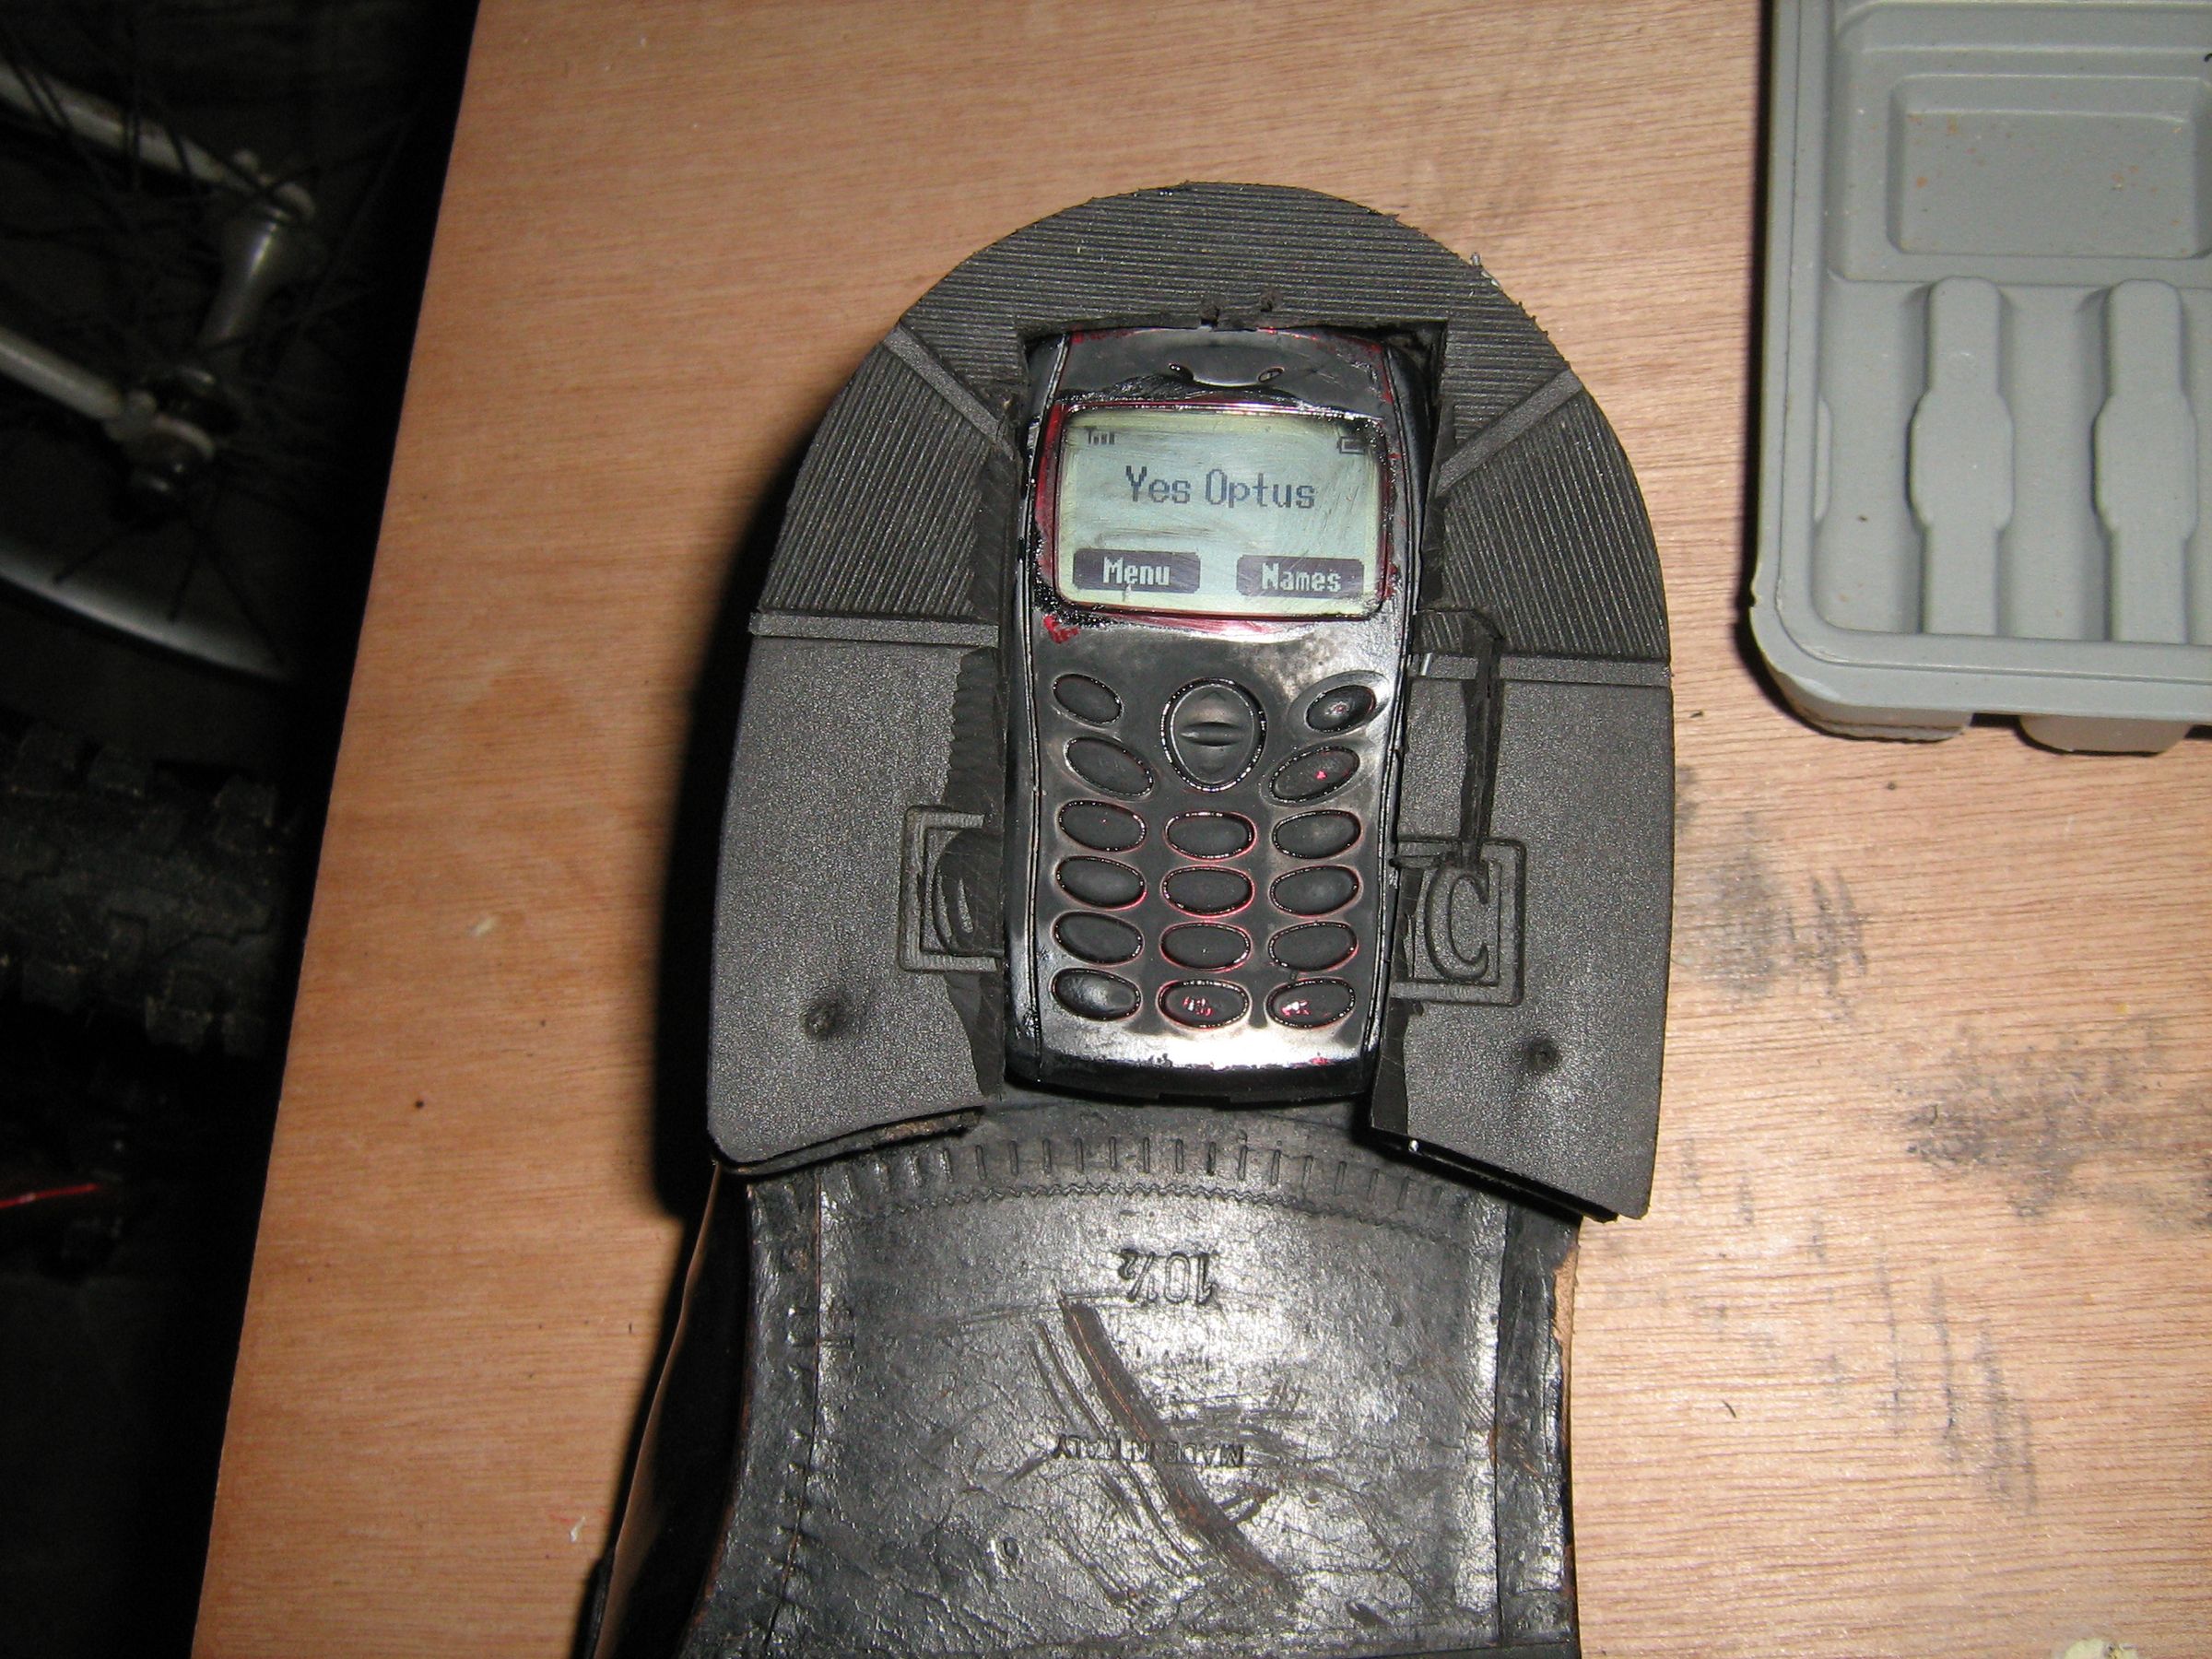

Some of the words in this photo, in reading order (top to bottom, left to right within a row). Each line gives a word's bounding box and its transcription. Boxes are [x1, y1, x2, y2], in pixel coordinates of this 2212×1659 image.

[1124, 465, 1191, 505] Yes
[1205, 468, 1316, 508] Optus
[1102, 556, 1171, 586] Menu
[1261, 562, 1342, 593] Names
[1165, 1441, 1244, 1467] MADE
